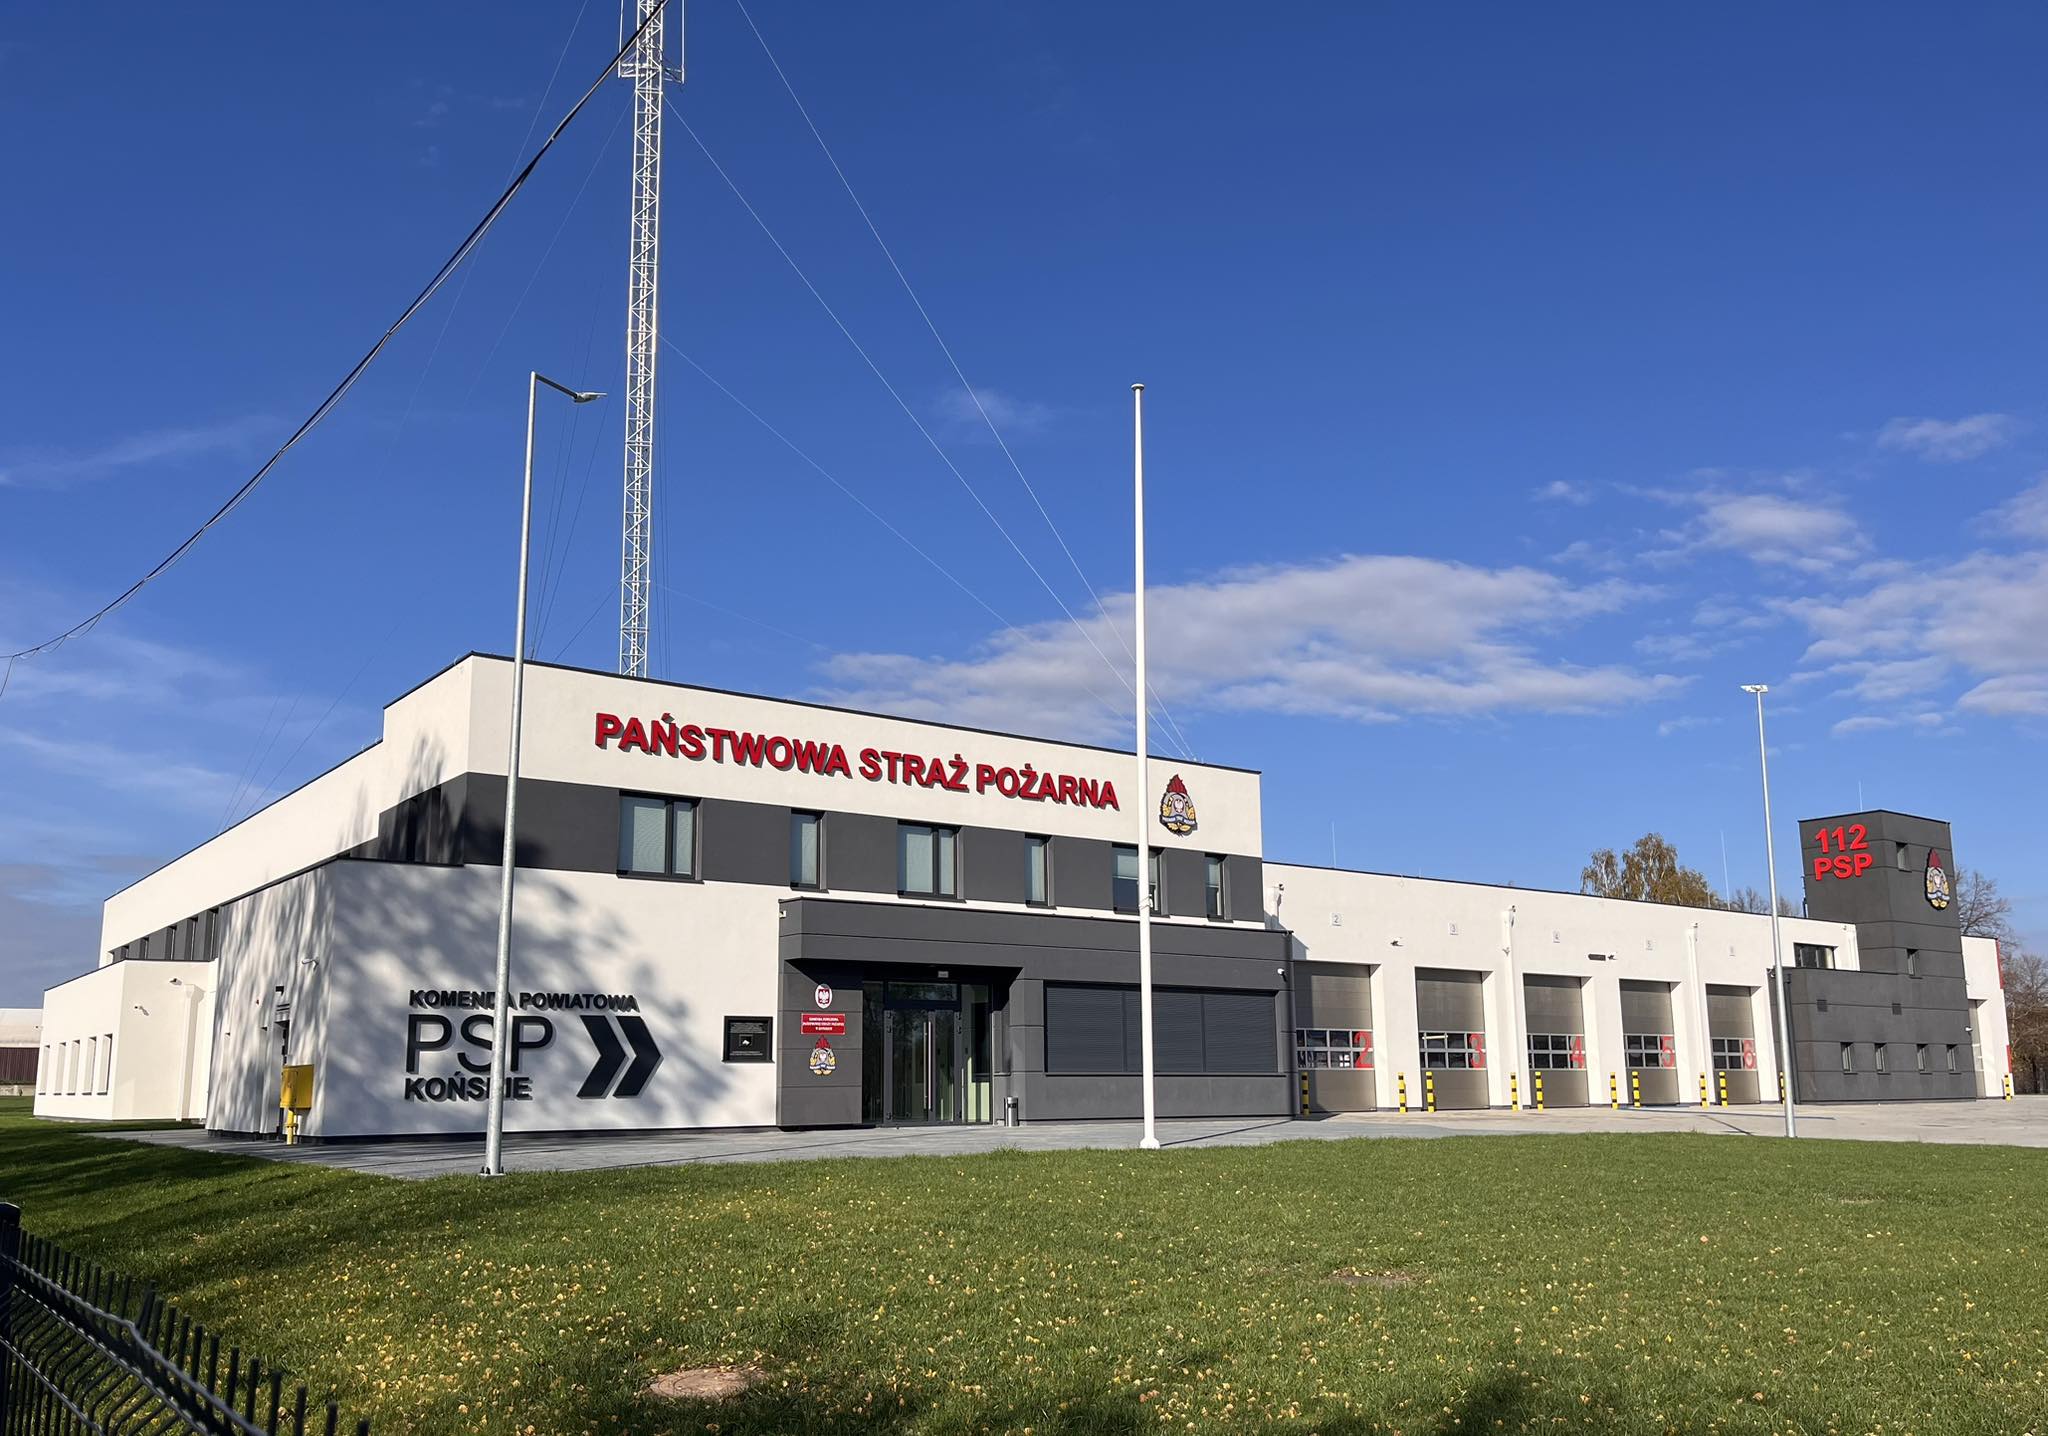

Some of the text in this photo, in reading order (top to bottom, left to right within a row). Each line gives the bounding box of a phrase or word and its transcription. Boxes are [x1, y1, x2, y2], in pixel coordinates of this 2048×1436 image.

[595, 712, 1119, 810] PAŃSTWOWA STRAŻ POŻARNA
[1815, 824, 1869, 853] 112
[1813, 853, 1873, 881] PSP
[519, 992, 639, 1012] POWIATOWA
[405, 1014, 554, 1074] PSP
[1353, 1031, 1375, 1068] 2
[1468, 1032, 1486, 1068] 3
[1570, 1035, 1585, 1069] 4
[1661, 1036, 1675, 1068] 5
[1743, 1039, 1756, 1070] 6
[404, 1071, 531, 1101] KOŃSIE
